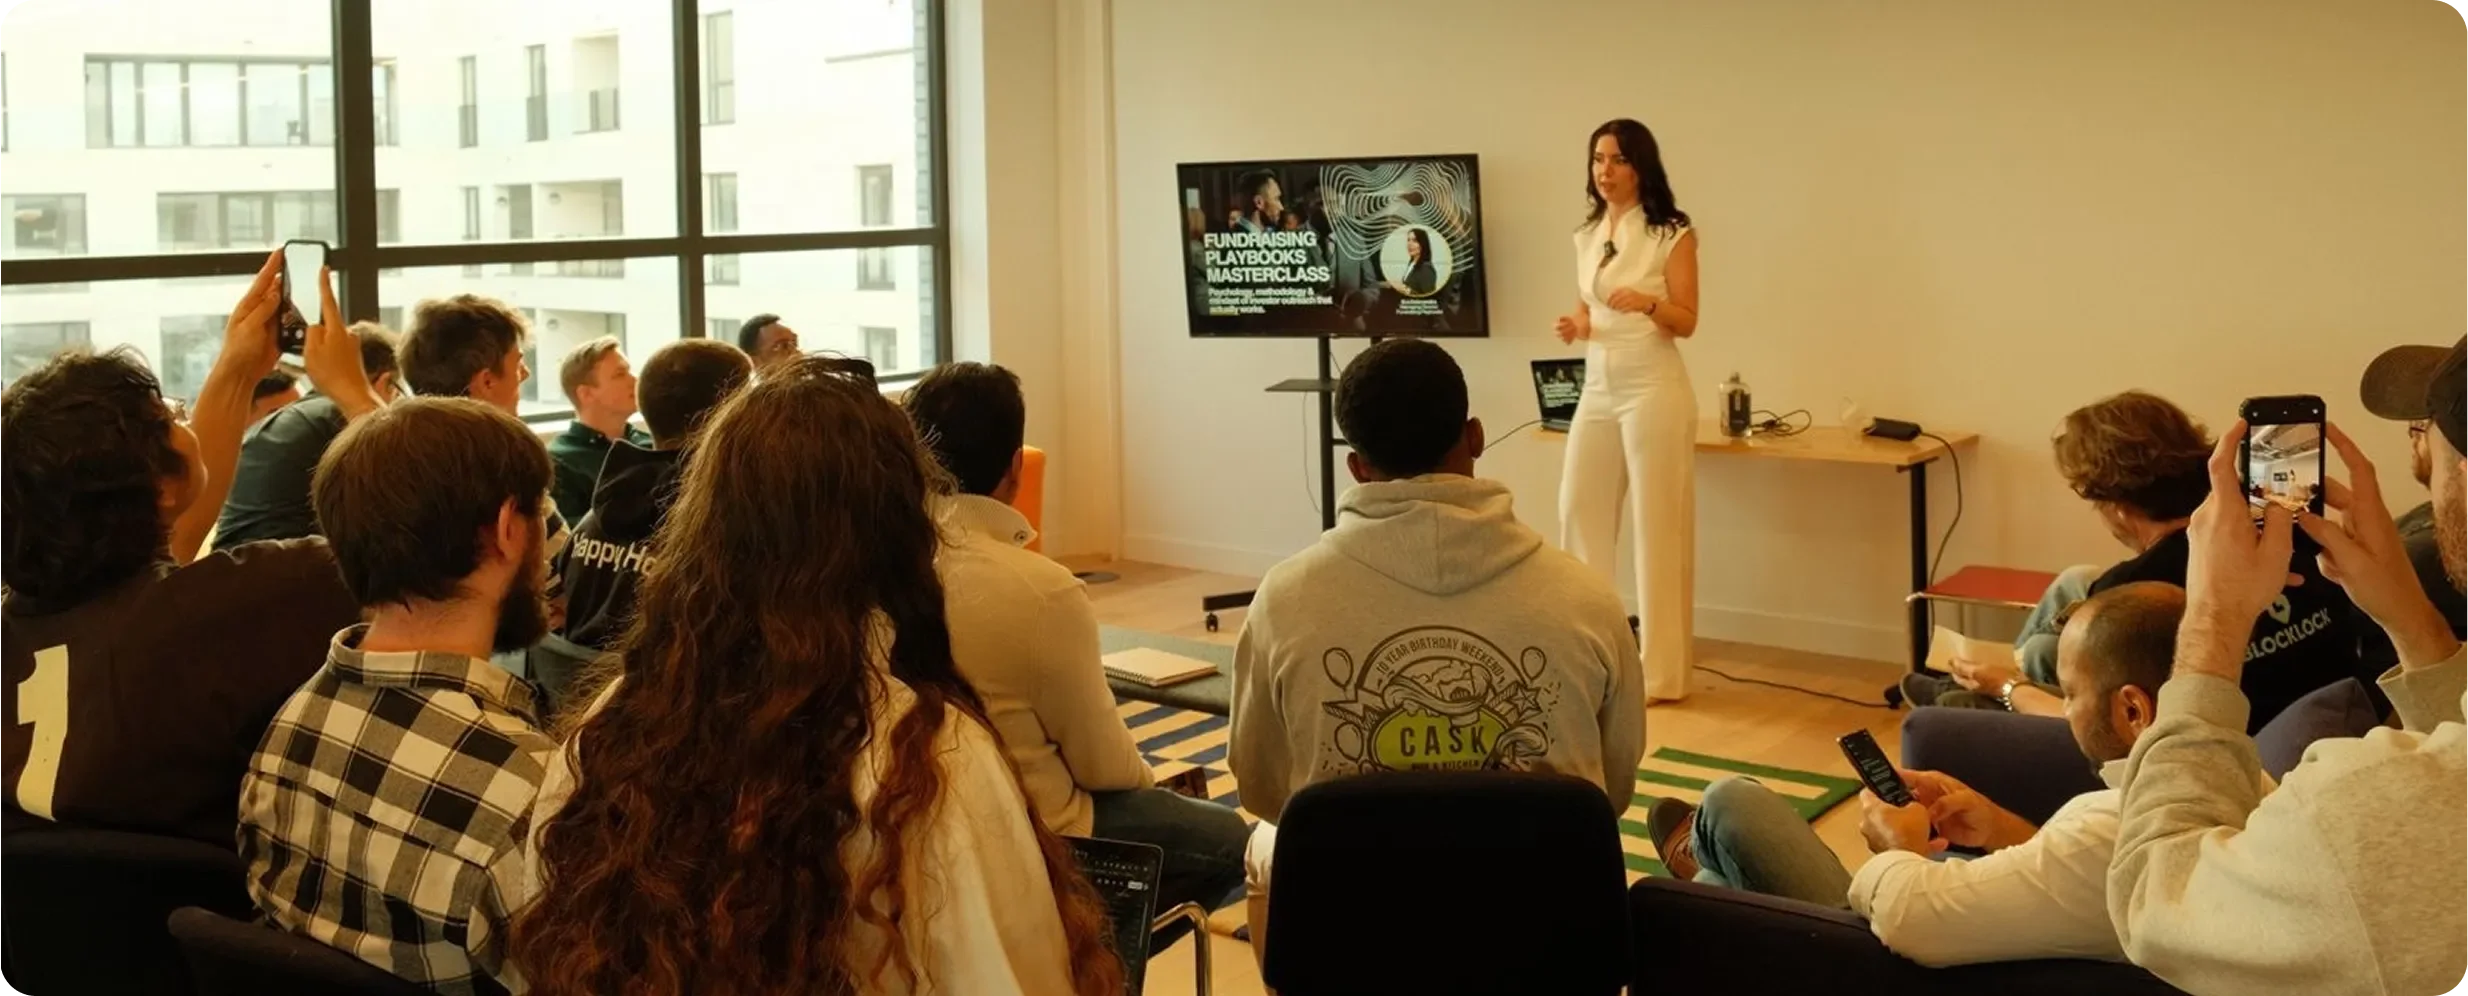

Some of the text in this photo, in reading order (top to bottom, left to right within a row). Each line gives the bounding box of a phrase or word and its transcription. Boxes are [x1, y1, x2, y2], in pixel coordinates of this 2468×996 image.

[1204, 231, 1317, 249] FUNDRAISING
[1205, 249, 1307, 266] PLAYBOOKS
[1206, 266, 1331, 283] MASTERCLASS
[1376, 636, 1506, 677] 10 YEAR BIRTHDAY WEEKEND
[16, 643, 69, 822] 1
[1401, 725, 1488, 757] CASK
